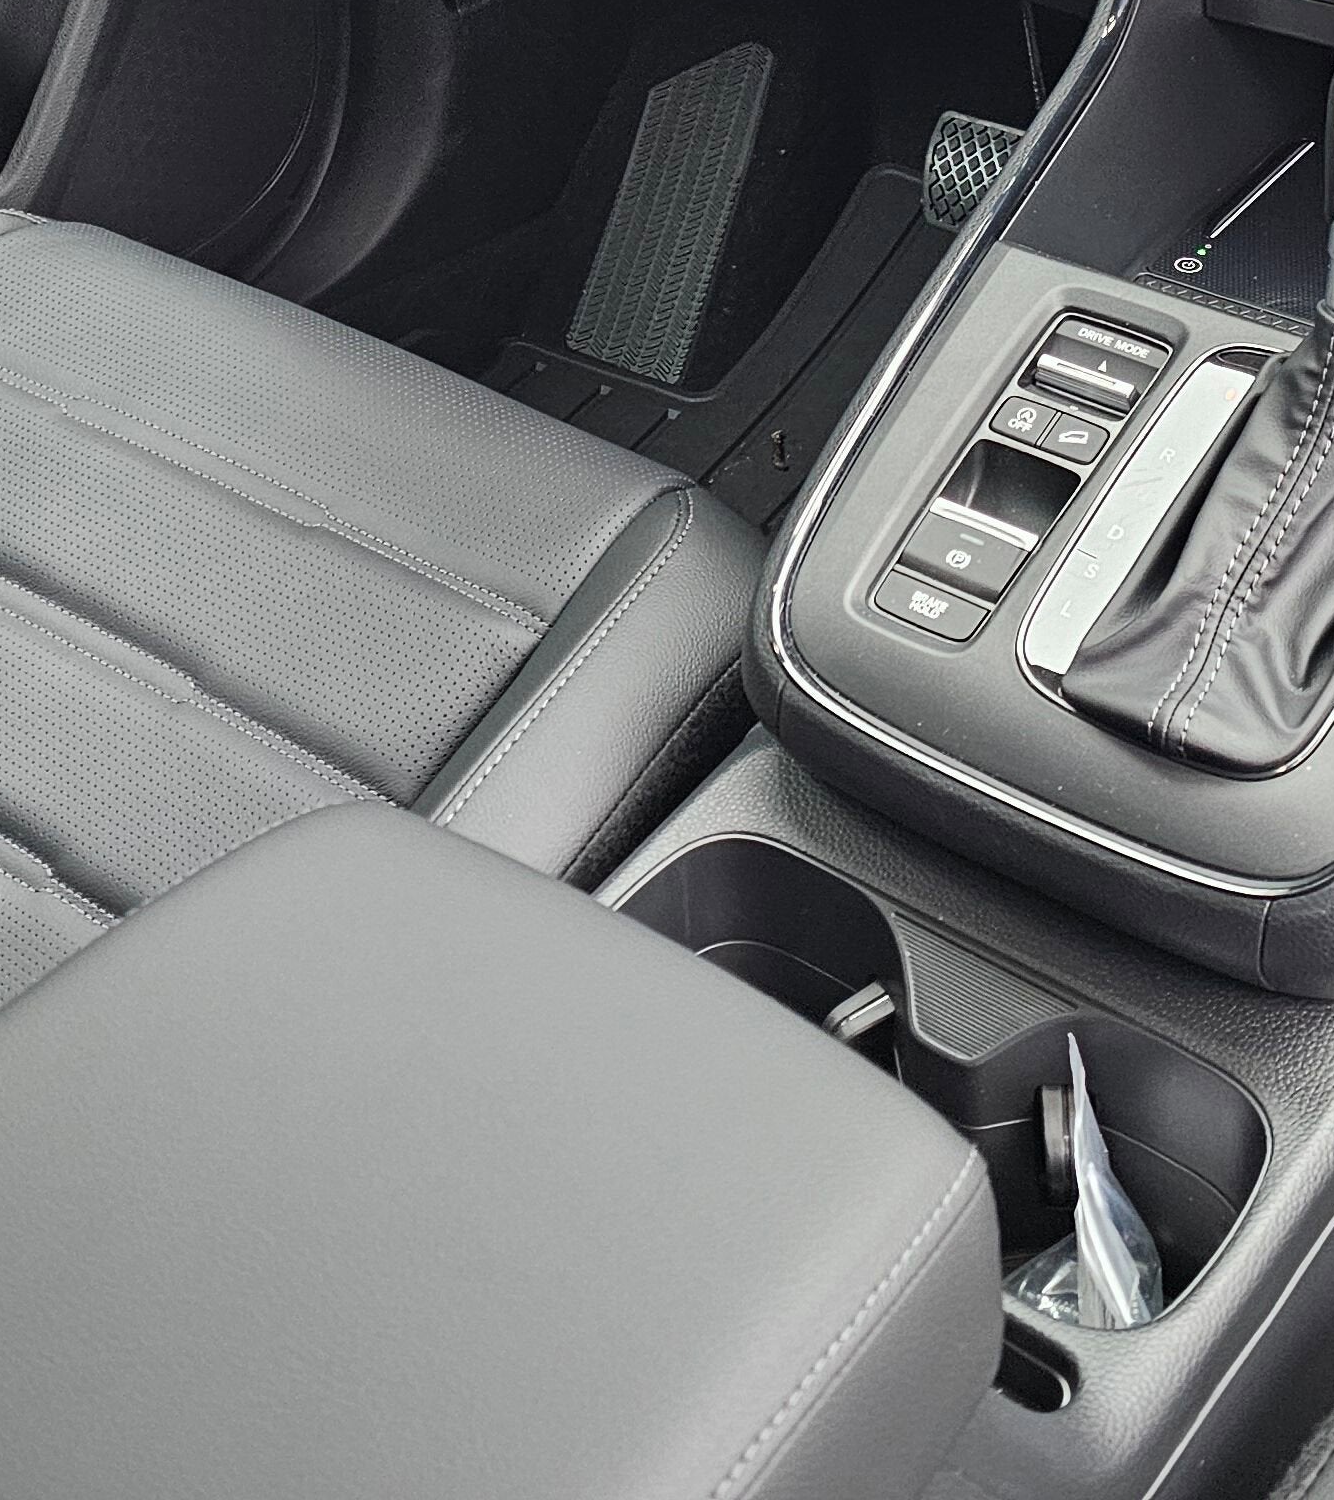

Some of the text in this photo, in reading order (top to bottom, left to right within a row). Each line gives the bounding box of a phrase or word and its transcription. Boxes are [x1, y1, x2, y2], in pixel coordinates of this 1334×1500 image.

[1077, 327, 1150, 359] DRIVE MODE
[1008, 417, 1033, 433] OFF
[1159, 449, 1176, 464] R
[1107, 525, 1124, 540] D
[1084, 563, 1100, 578] S
